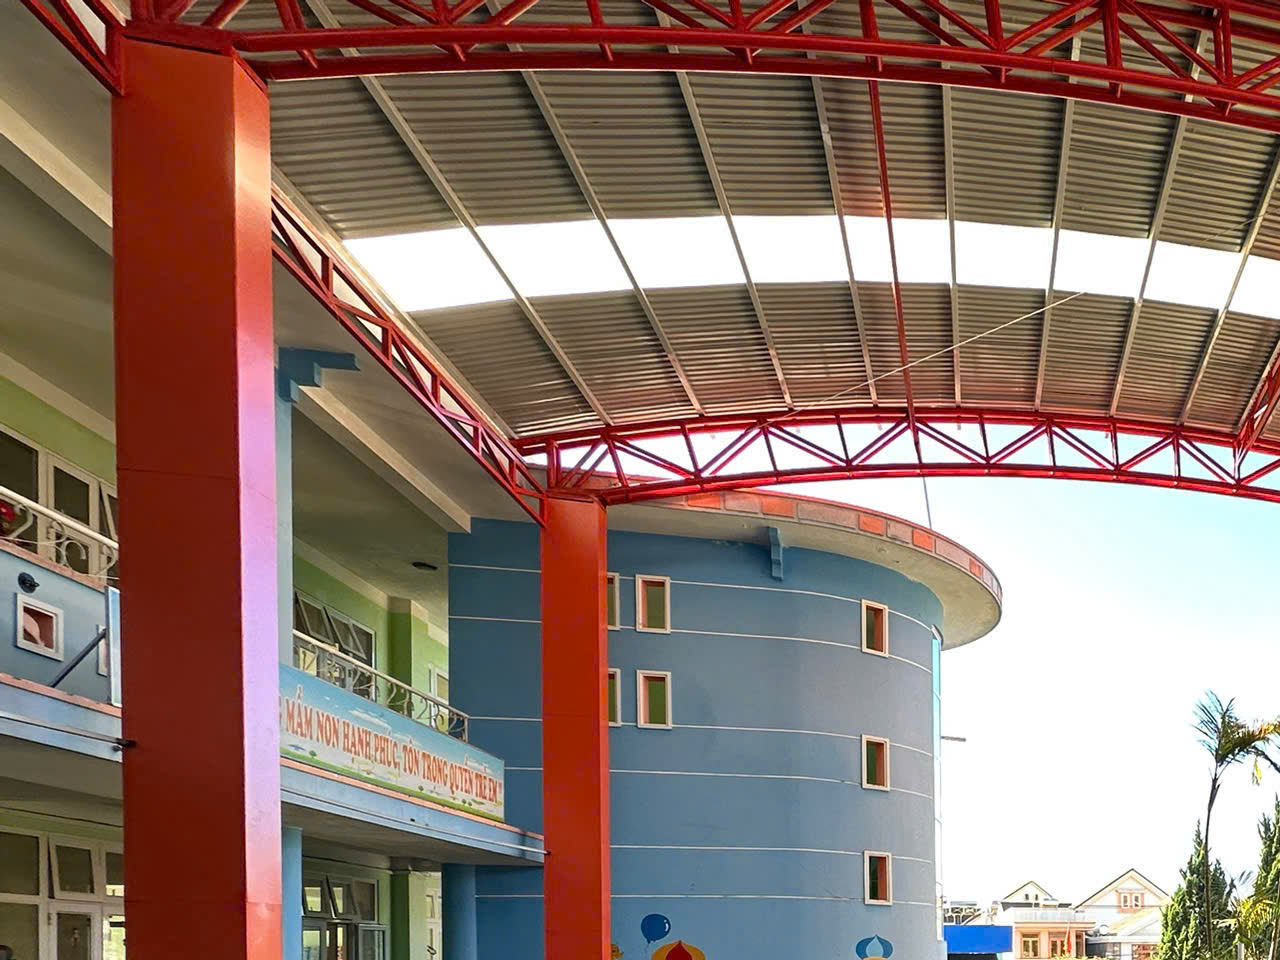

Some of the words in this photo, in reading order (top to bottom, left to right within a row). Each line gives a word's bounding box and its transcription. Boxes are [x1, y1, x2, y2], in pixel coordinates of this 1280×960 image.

[316, 710, 339, 748] NON
[343, 720, 371, 763] HẠNH
[403, 737, 420, 776] TÔN
[422, 751, 448, 790] TRỌNG
